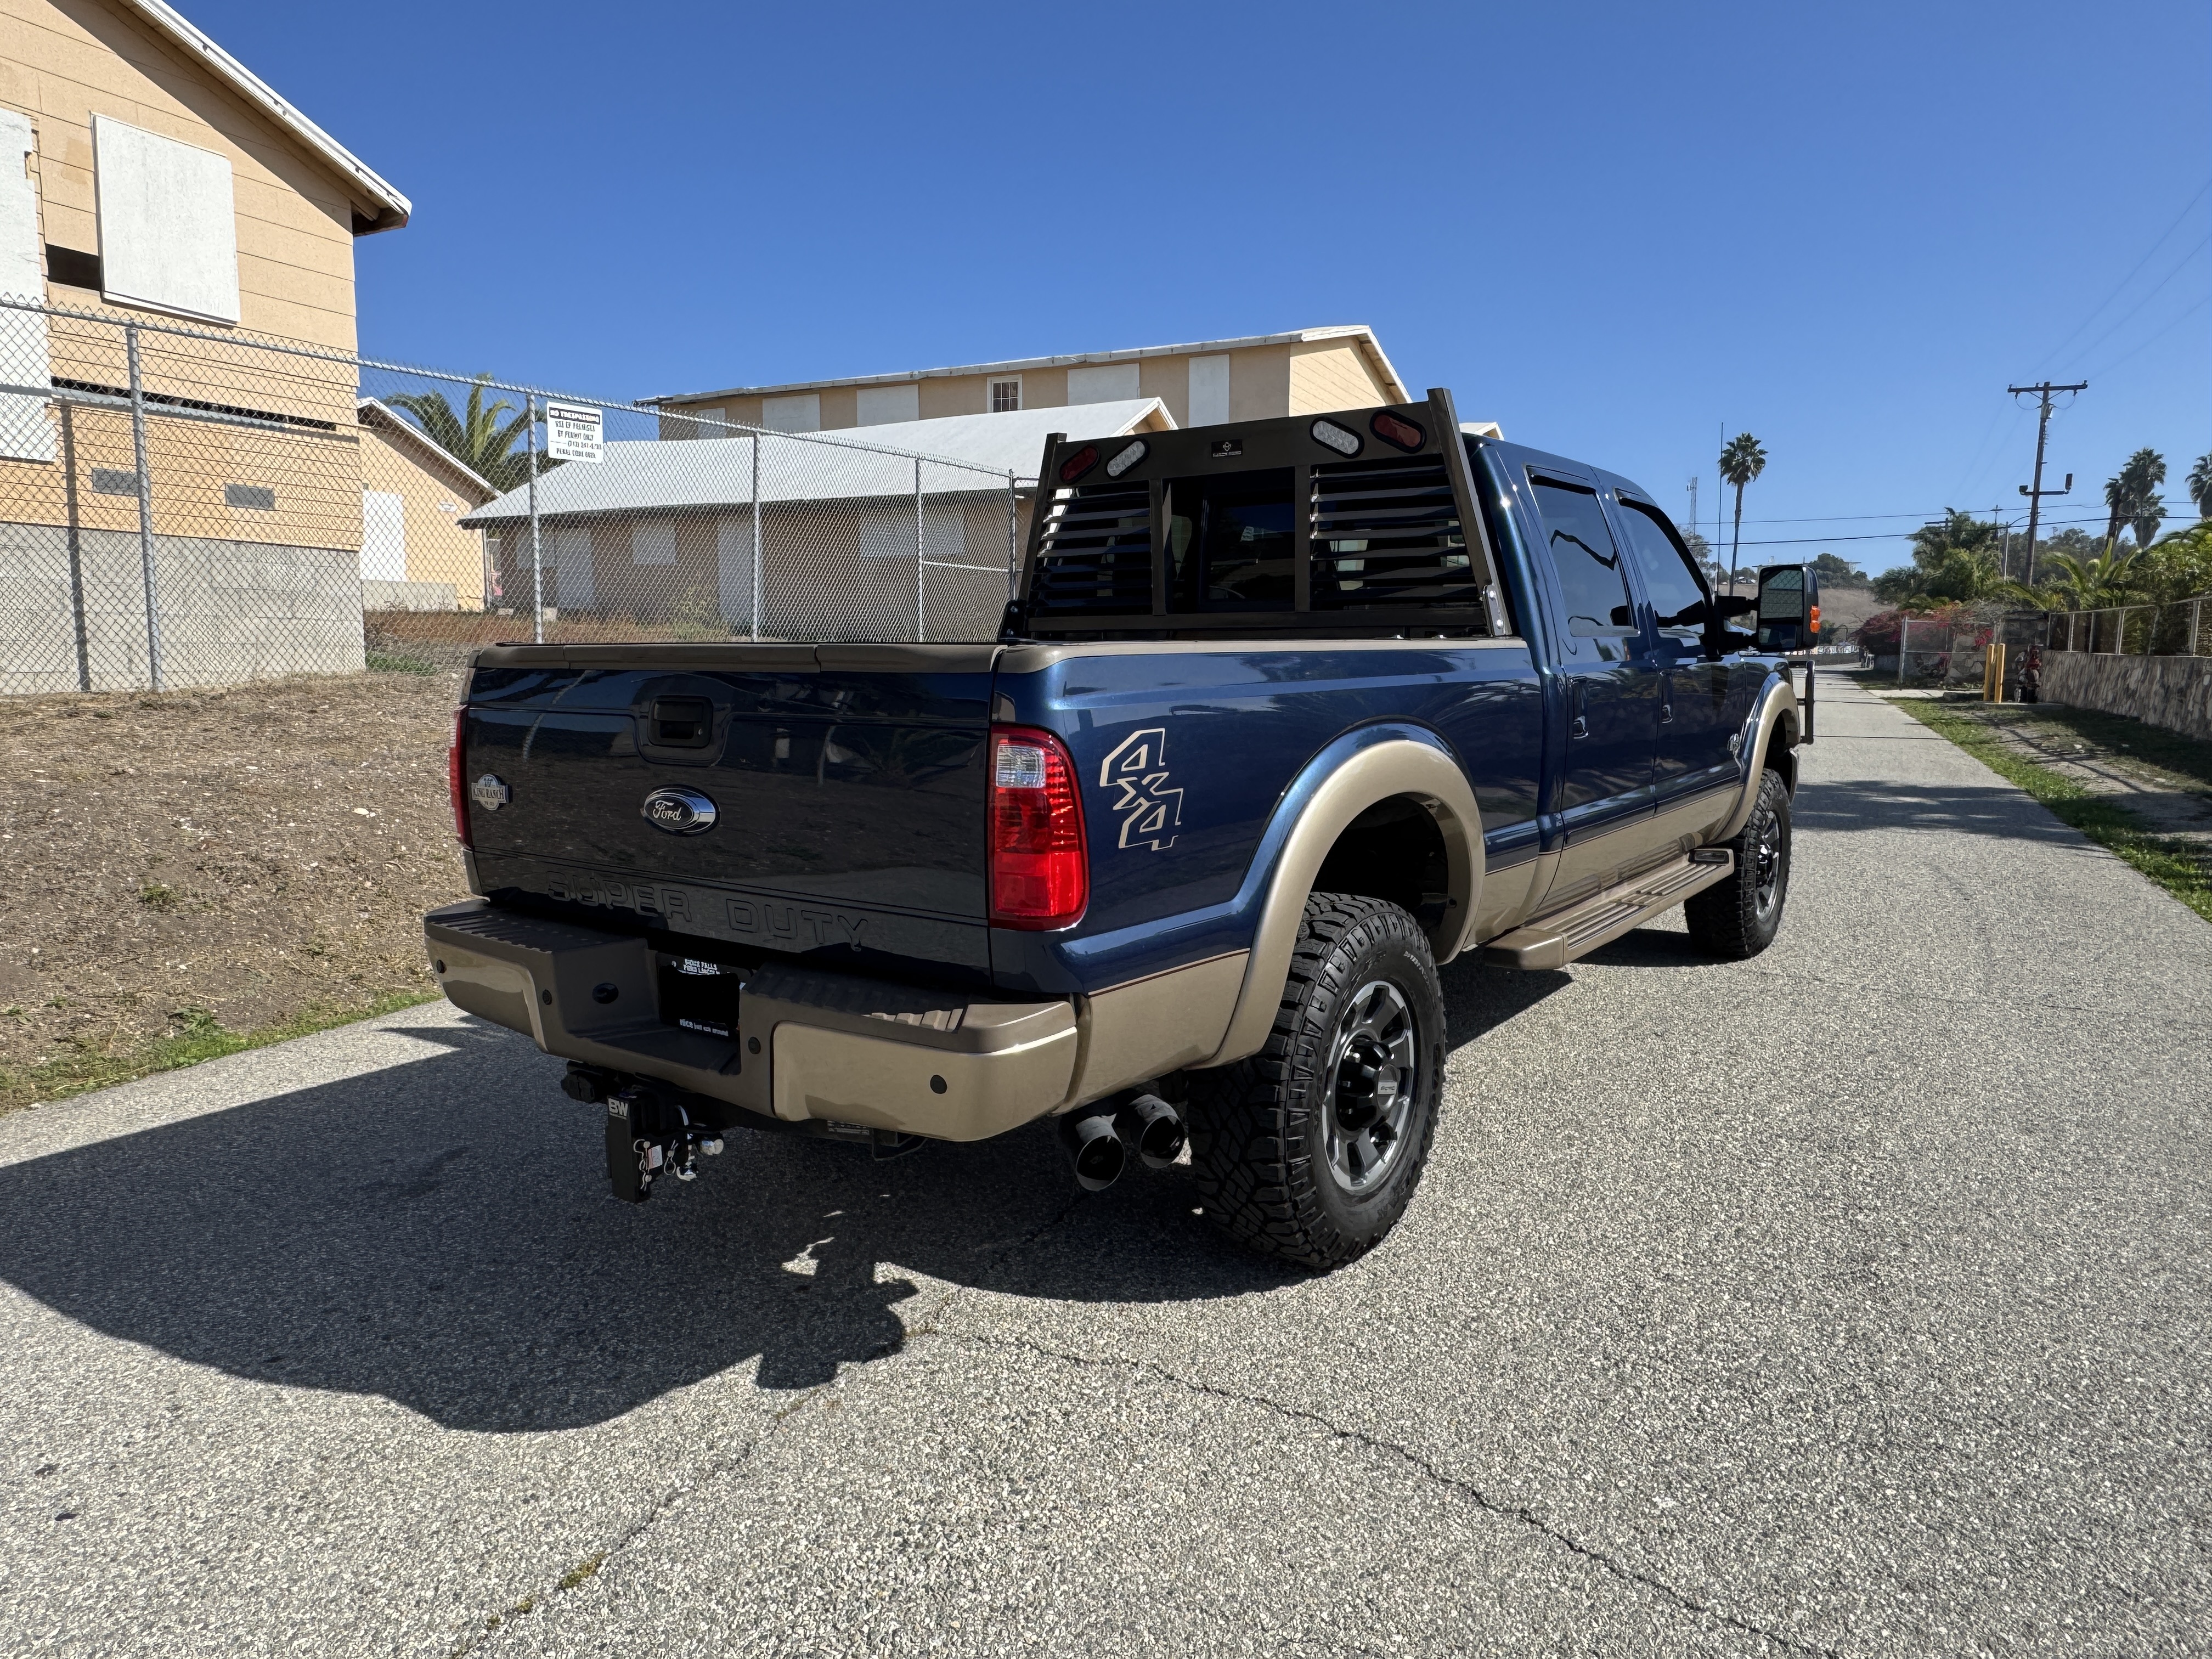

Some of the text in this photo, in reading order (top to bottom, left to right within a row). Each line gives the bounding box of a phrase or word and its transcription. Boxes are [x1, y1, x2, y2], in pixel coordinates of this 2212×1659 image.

[653, 800, 682, 821] Ford
[545, 871, 868, 952] SUPER DUTY
